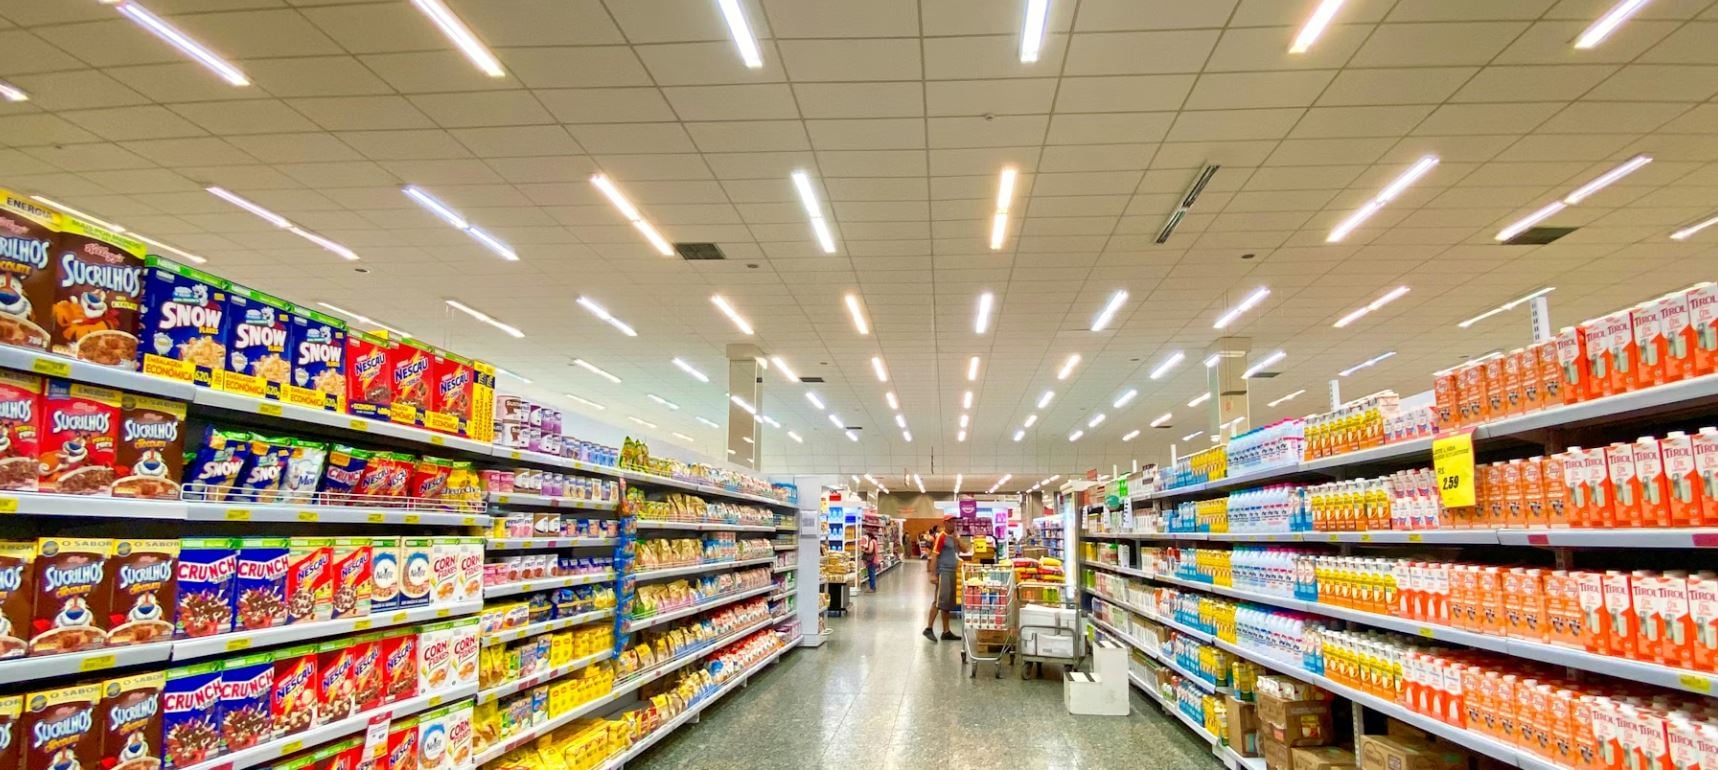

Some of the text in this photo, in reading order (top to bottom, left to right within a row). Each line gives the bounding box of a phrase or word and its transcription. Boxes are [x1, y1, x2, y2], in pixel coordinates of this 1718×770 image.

[0, 237, 50, 269] RILHOS
[62, 253, 142, 298] SUCRILHOS
[1660, 305, 1687, 319] TIROL
[1690, 296, 1718, 309] TIROL
[159, 301, 222, 329] SNOW
[1634, 314, 1657, 326] TIROL
[235, 324, 287, 349] SNOW
[1587, 330, 1605, 342] TIROL
[1608, 324, 1630, 335] TIROL
[298, 342, 342, 365] SNOW
[1557, 339, 1577, 350] TIROL
[355, 352, 386, 376] NESCAU
[394, 357, 428, 383] NESCAU
[440, 370, 469, 394] NESCAU
[53, 410, 111, 434] SUCRILHOS
[124, 419, 178, 442] SUCRILHOS
[1609, 454, 1631, 465] TIROL
[1634, 451, 1658, 462] TIROL
[1664, 448, 1691, 459] TIROL
[1694, 443, 1718, 455] TIRO
[198, 460, 244, 480] SNOW
[1565, 460, 1583, 469] TIROL
[1584, 458, 1604, 467] TIROL
[178, 556, 236, 581] CRUNCH
[238, 555, 289, 578] CRUNCH
[297, 553, 329, 581] NESCAU
[341, 552, 369, 577] NESCAU
[434, 555, 456, 573] CORN
[461, 554, 480, 571] CORN
[45, 561, 104, 592] SUCRILHOS
[120, 560, 173, 590] SUCRILHOS
[1579, 583, 1599, 593] TIROL
[1605, 584, 1626, 595] TIROL
[1633, 586, 1657, 598] TIROL
[1658, 588, 1684, 599] TIROL
[1689, 590, 1717, 602] TIROL
[387, 640, 414, 670] NESCAU
[424, 640, 447, 661] CORN
[455, 634, 476, 655] CORN
[222, 670, 275, 698] CRUNCH
[275, 662, 315, 702] NESCAU
[322, 655, 354, 694] NESCAU
[165, 679, 222, 710] CRUNCH
[111, 693, 158, 732] SUCRILHOS
[34, 708, 93, 749] SUCRILHOS
[450, 720, 469, 740] CORN
[1669, 733, 1694, 747] TIROL
[1697, 740, 1718, 753] TIRO
